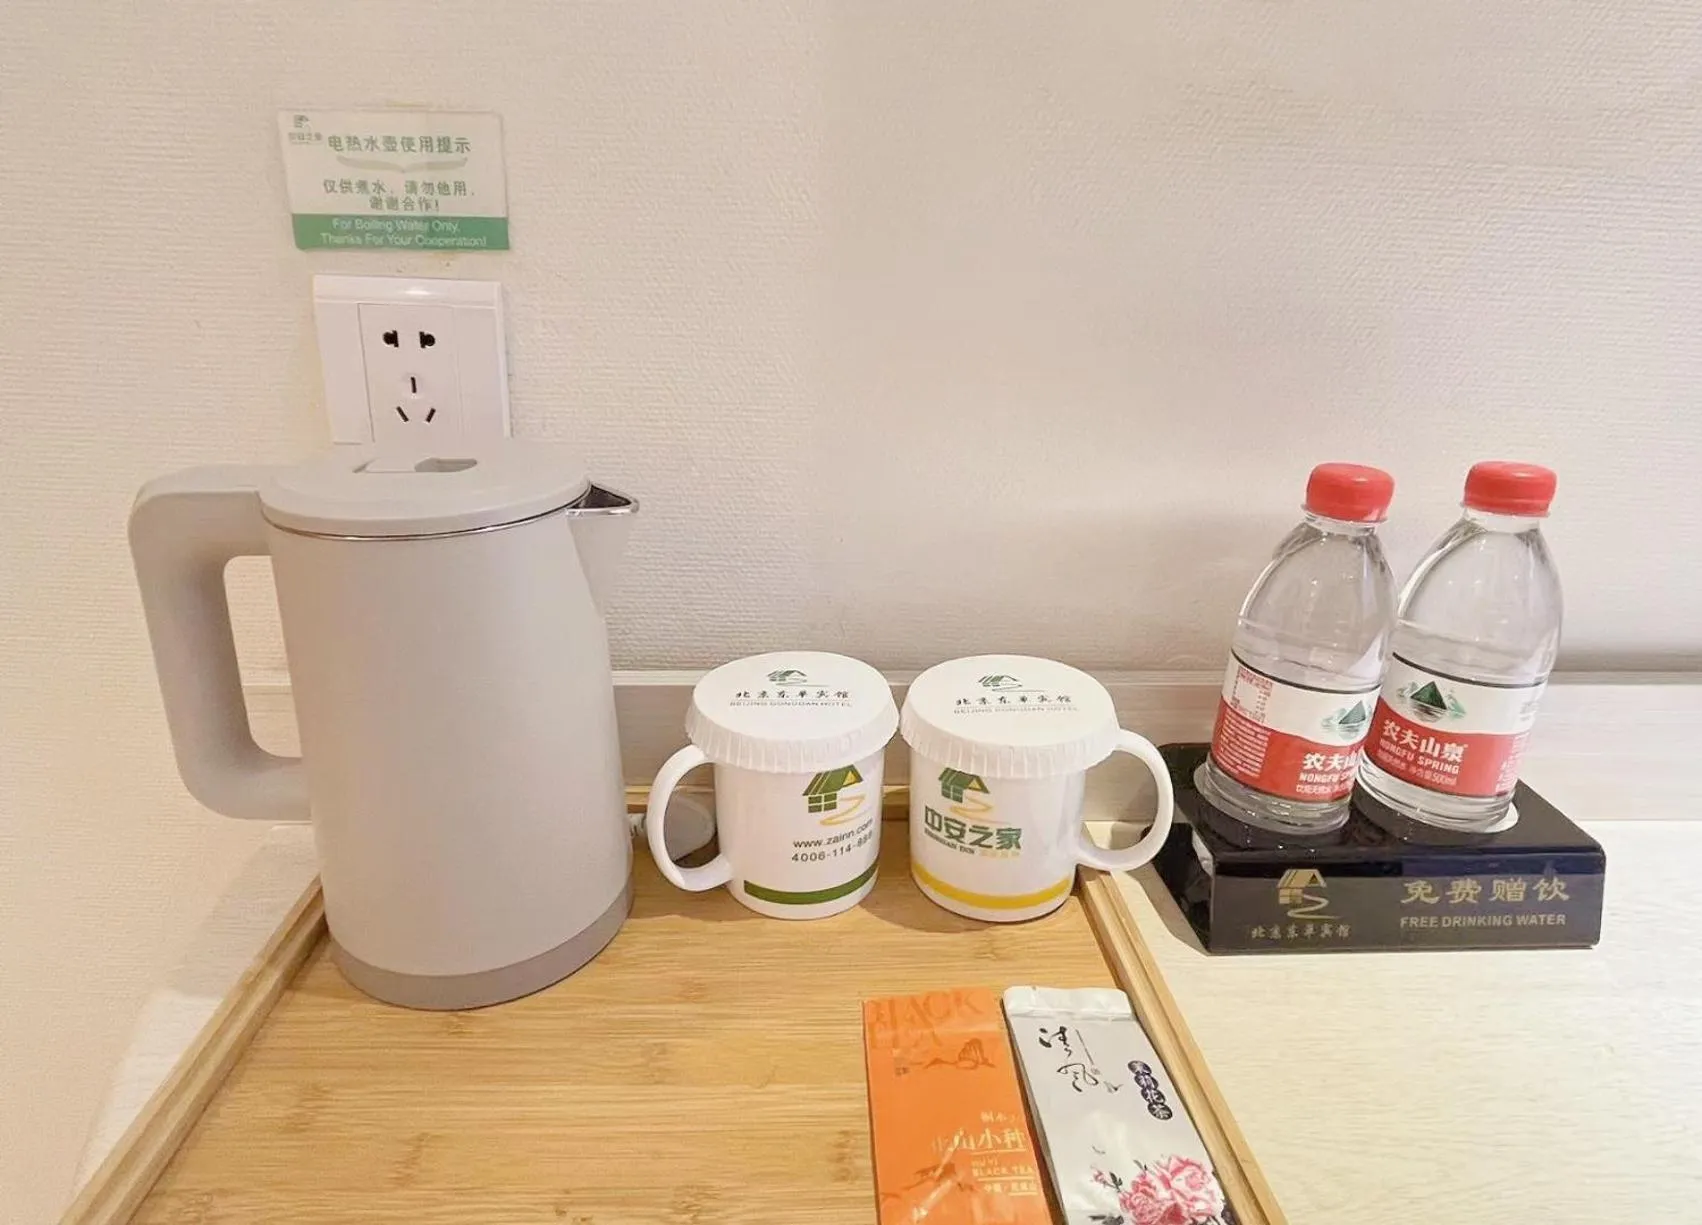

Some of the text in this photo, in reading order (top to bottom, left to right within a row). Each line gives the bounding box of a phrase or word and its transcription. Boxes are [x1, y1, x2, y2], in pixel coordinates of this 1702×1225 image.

[328, 135, 471, 154] 电热水壶使用提示
[331, 218, 352, 231] For
[355, 218, 393, 234] Boiling
[396, 219, 429, 232] Water
[320, 232, 362, 245] Thanks
[364, 233, 384, 245] For
[387, 234, 412, 247] Your
[1382, 719, 1464, 763] 农夫山泉
[1379, 737, 1460, 775] NONGFU SPRING
[924, 805, 1022, 850] 中安之家
[1401, 876, 1571, 905] 免费赠饮
[1400, 914, 1567, 929] FREE DRINKING WATER
